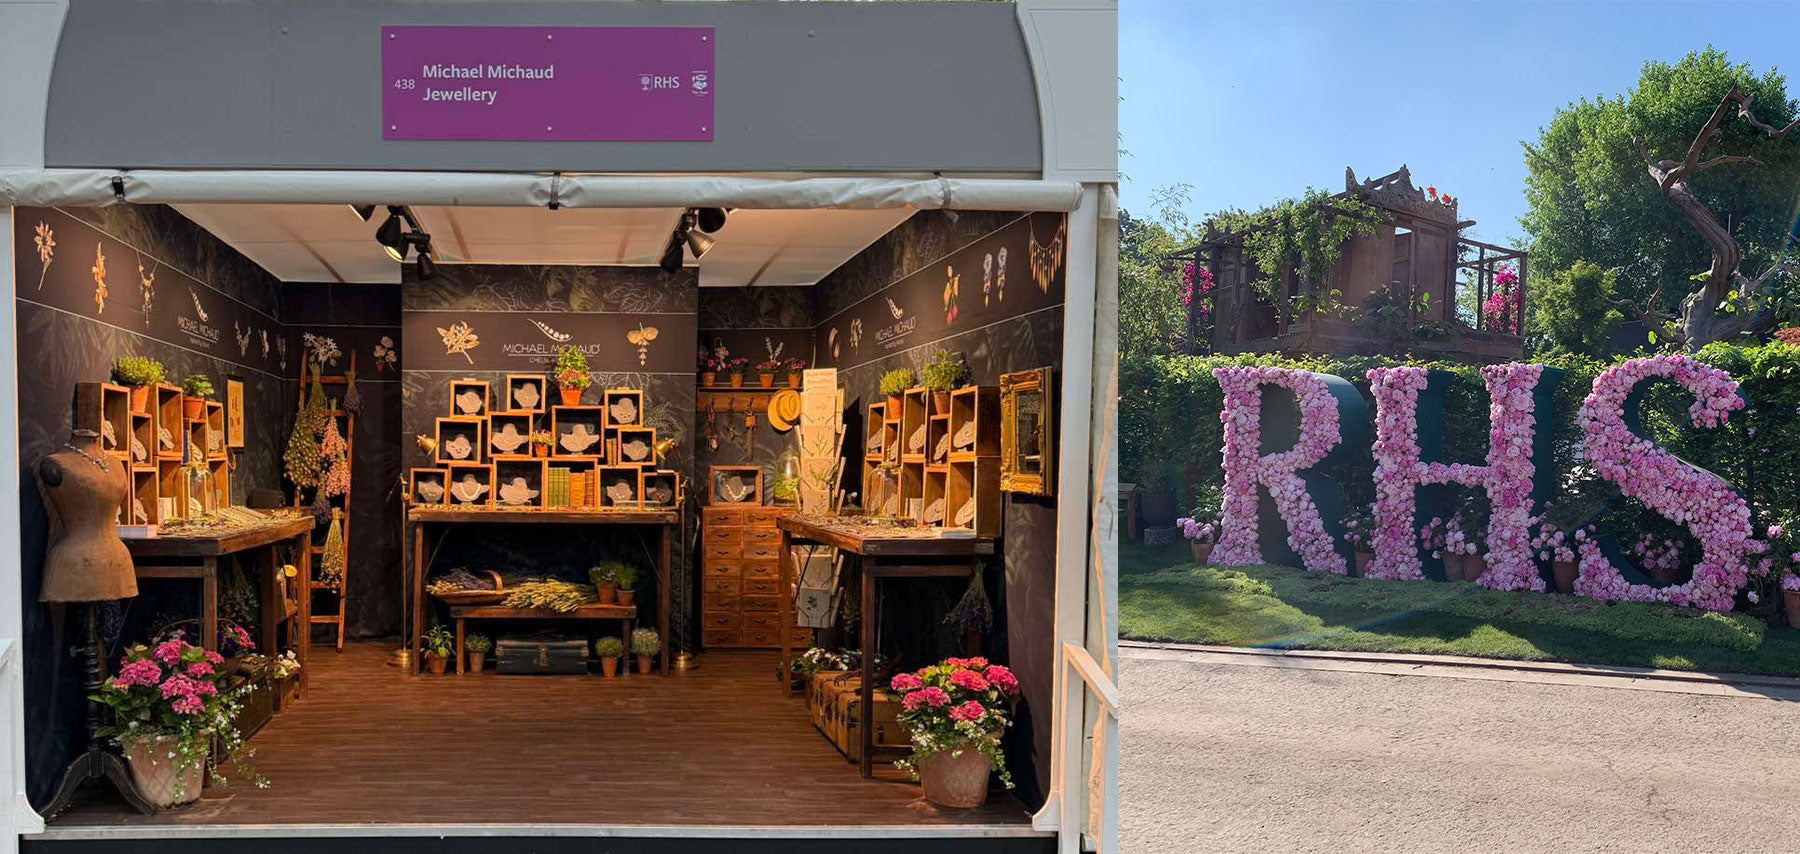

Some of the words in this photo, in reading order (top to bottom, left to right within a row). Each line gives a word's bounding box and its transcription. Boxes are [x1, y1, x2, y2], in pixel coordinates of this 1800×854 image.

[423, 64, 483, 79] Michael
[488, 64, 554, 79] Michaud
[394, 79, 416, 90] 438
[654, 76, 680, 89] RHS
[422, 87, 497, 105] Jewellery
[502, 343, 548, 354] MICHAEL
[1207, 353, 1755, 613] RHS
